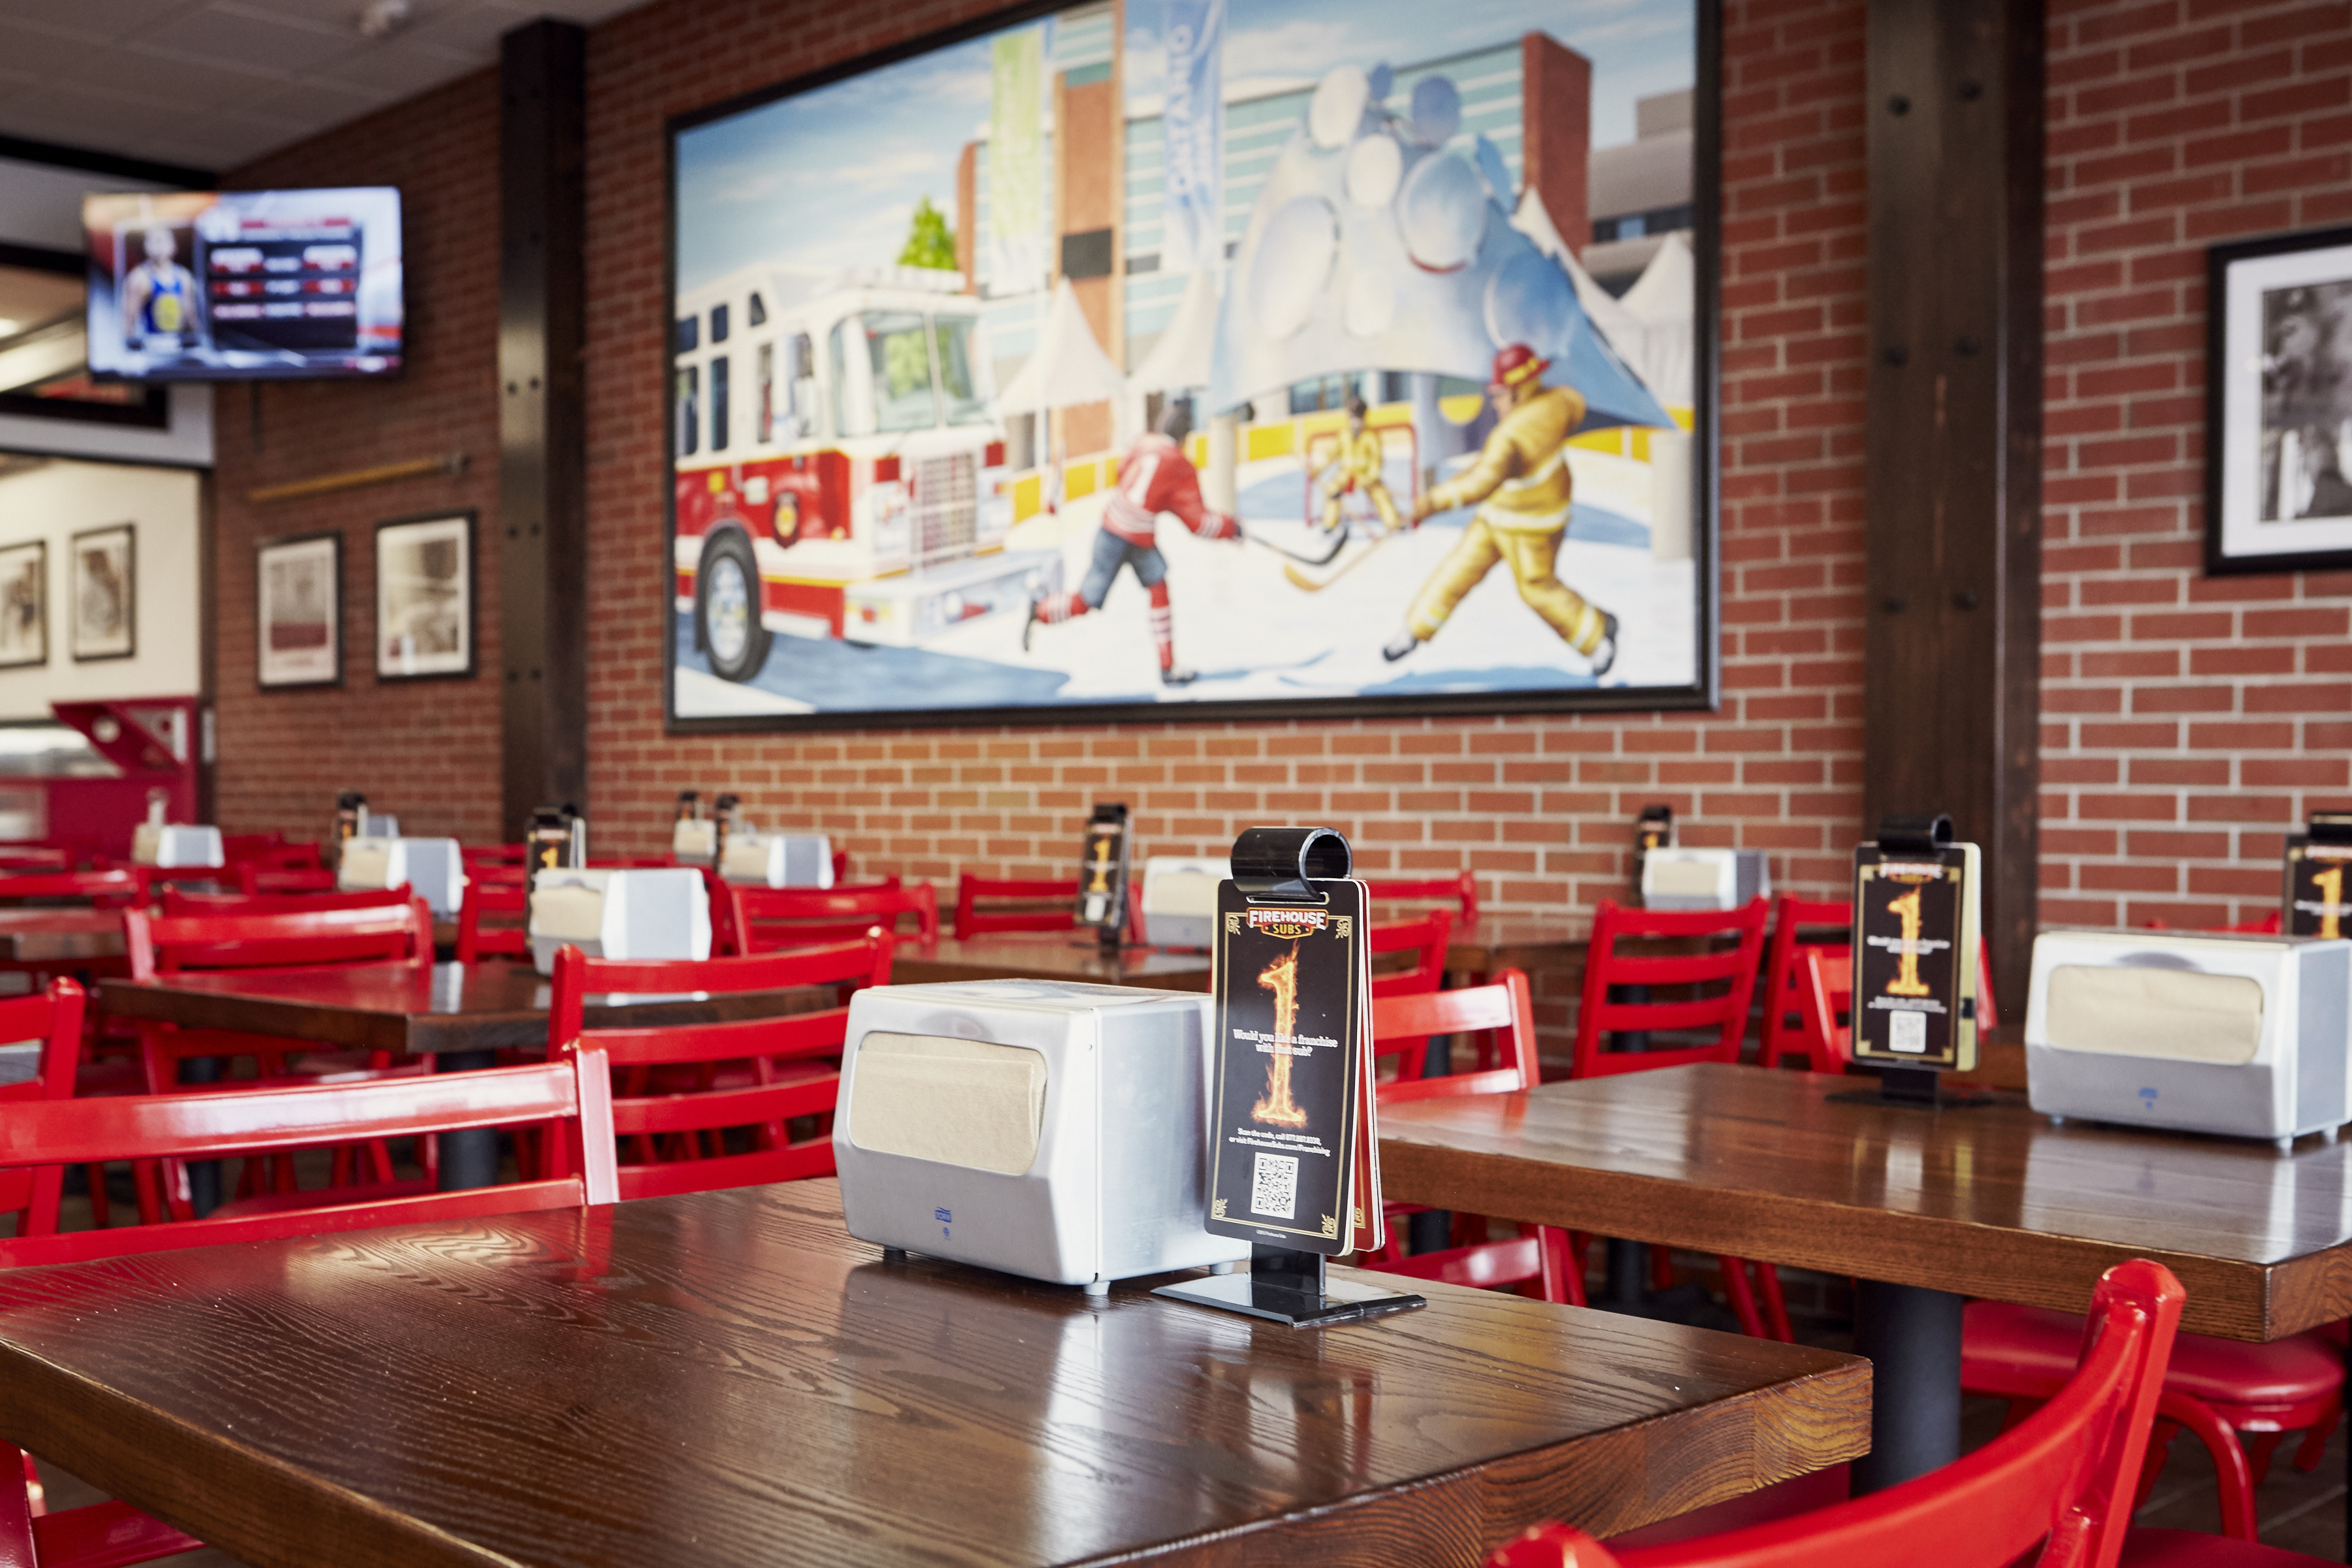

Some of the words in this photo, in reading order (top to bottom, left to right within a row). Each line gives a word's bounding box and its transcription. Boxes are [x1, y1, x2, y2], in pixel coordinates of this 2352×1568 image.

[1249, 910, 1327, 930] FIREHOUSE
[1272, 923, 1301, 935] SUBS
[1885, 890, 1931, 996] 1
[1233, 1029, 1258, 1041] Would
[1258, 1033, 1274, 1043] you
[1298, 1034, 1338, 1048] franchise
[1252, 956, 1307, 1128] 1
[1255, 1042, 1274, 1053] with
[1292, 1045, 1313, 1056] sub?
